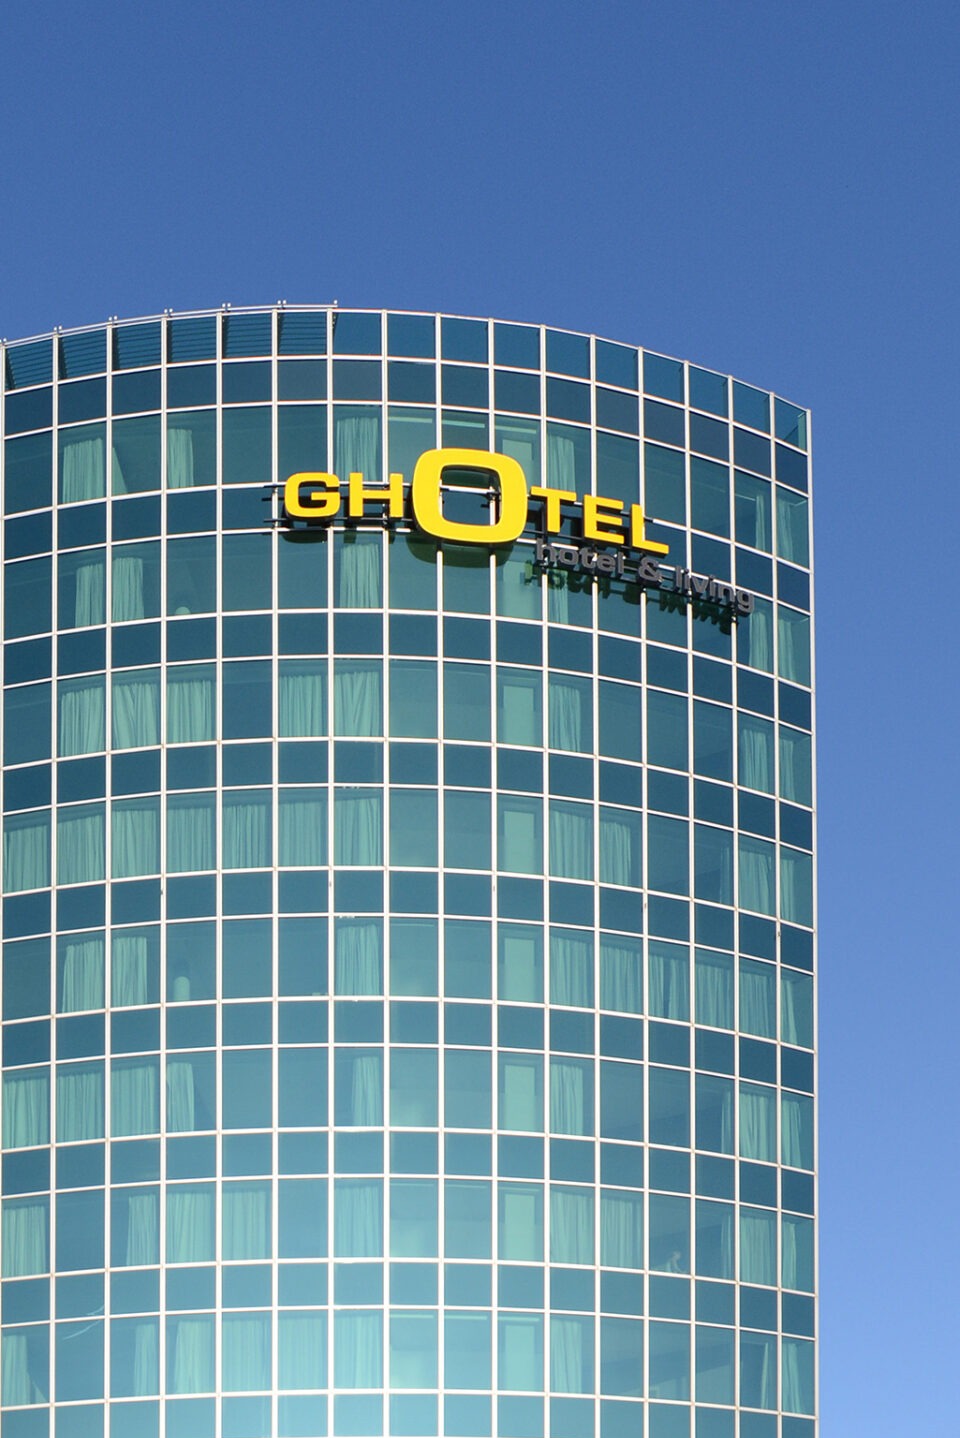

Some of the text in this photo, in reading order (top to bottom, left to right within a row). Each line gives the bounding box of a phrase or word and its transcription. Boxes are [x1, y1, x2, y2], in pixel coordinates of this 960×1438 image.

[284, 447, 670, 556] GHOTEL
[536, 538, 756, 615] hotel & living
